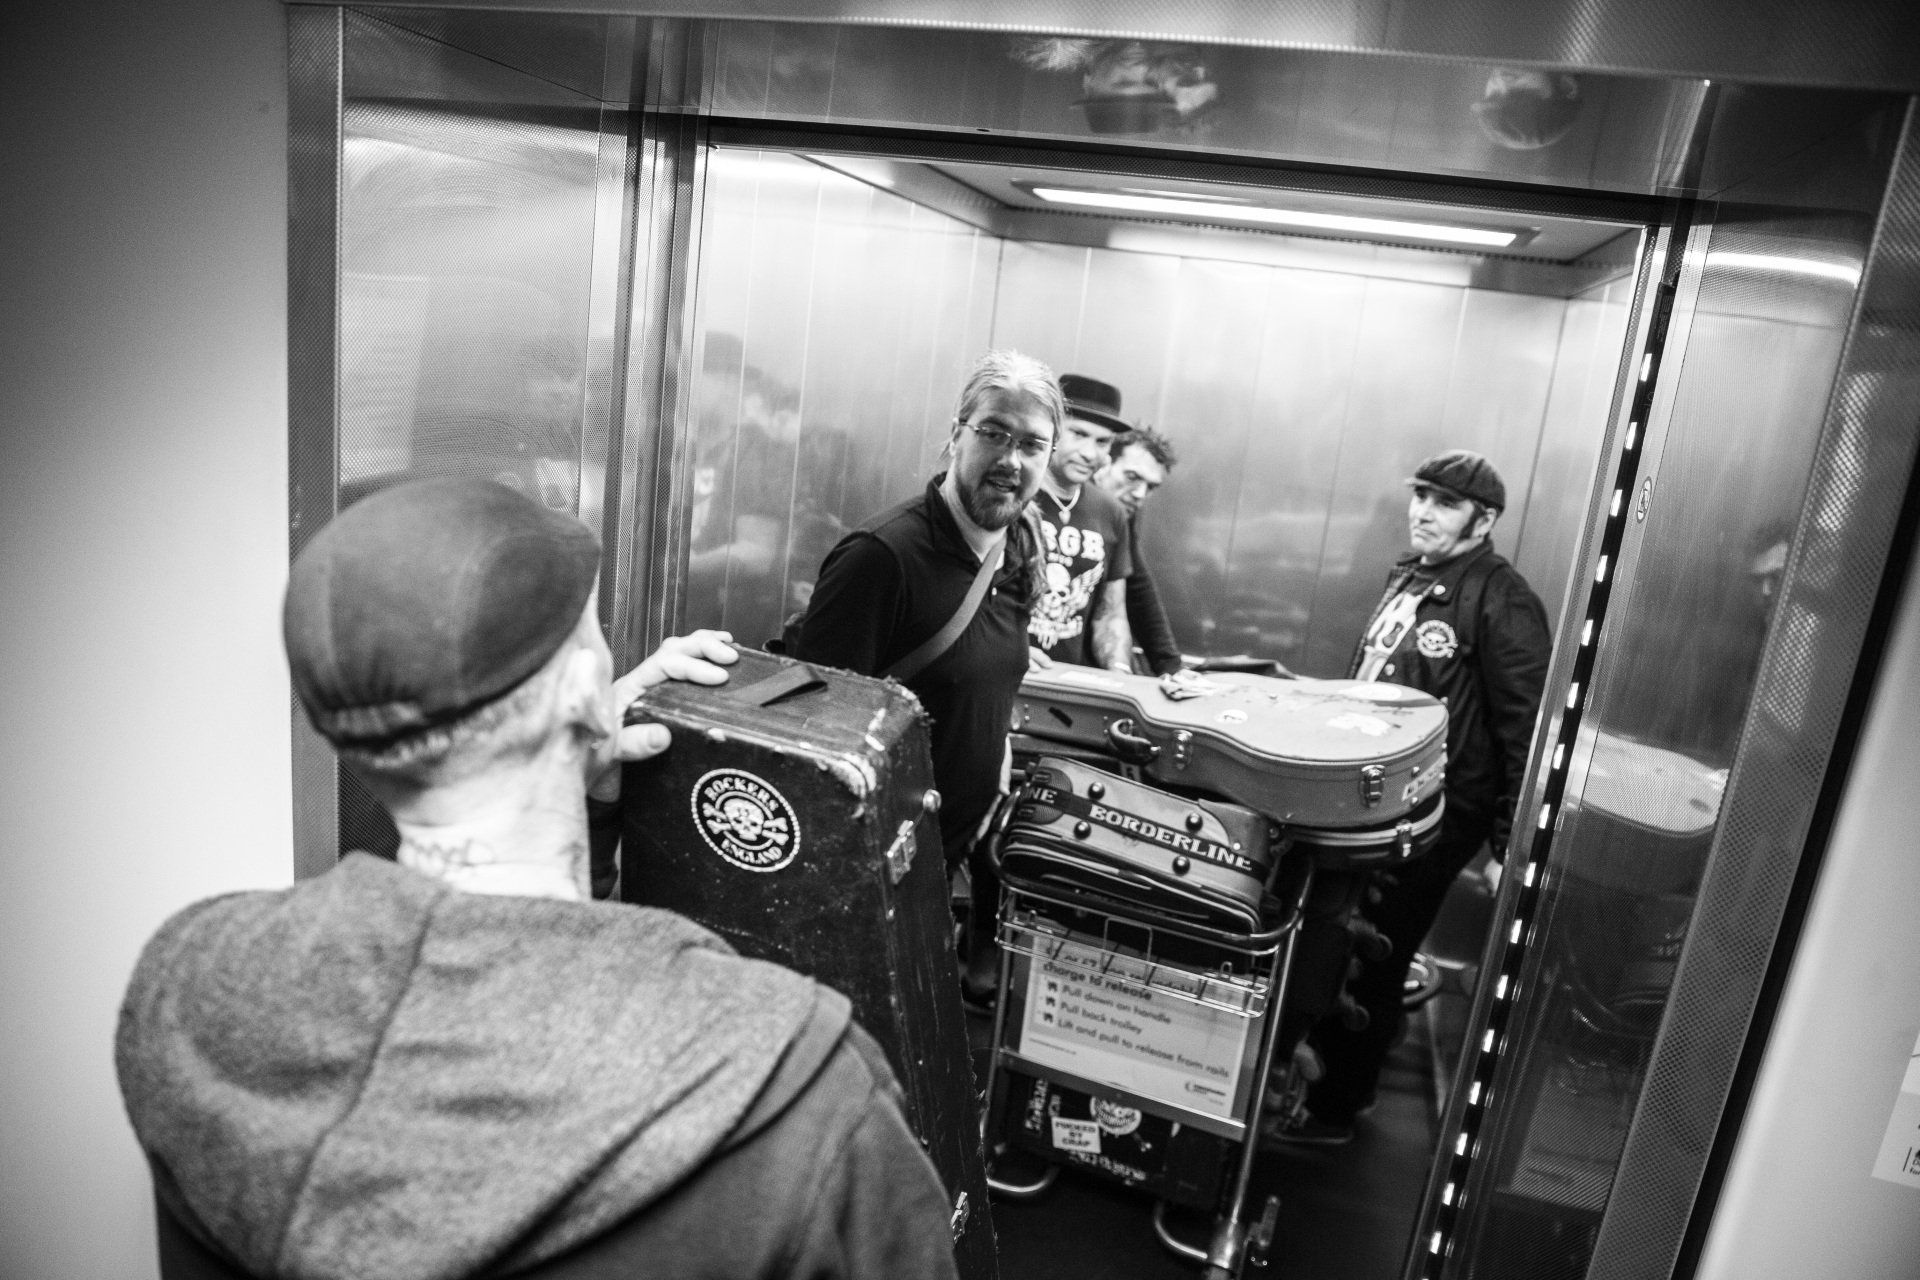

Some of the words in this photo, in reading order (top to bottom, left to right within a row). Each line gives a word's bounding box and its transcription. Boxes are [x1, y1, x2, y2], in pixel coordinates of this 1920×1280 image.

[704, 776, 779, 812] ROCKERS
[721, 838, 783, 865] ENGLAND
[1089, 803, 1253, 871] BORDERLINE
[1043, 961, 1085, 982] charge
[1105, 981, 1152, 1000] release
